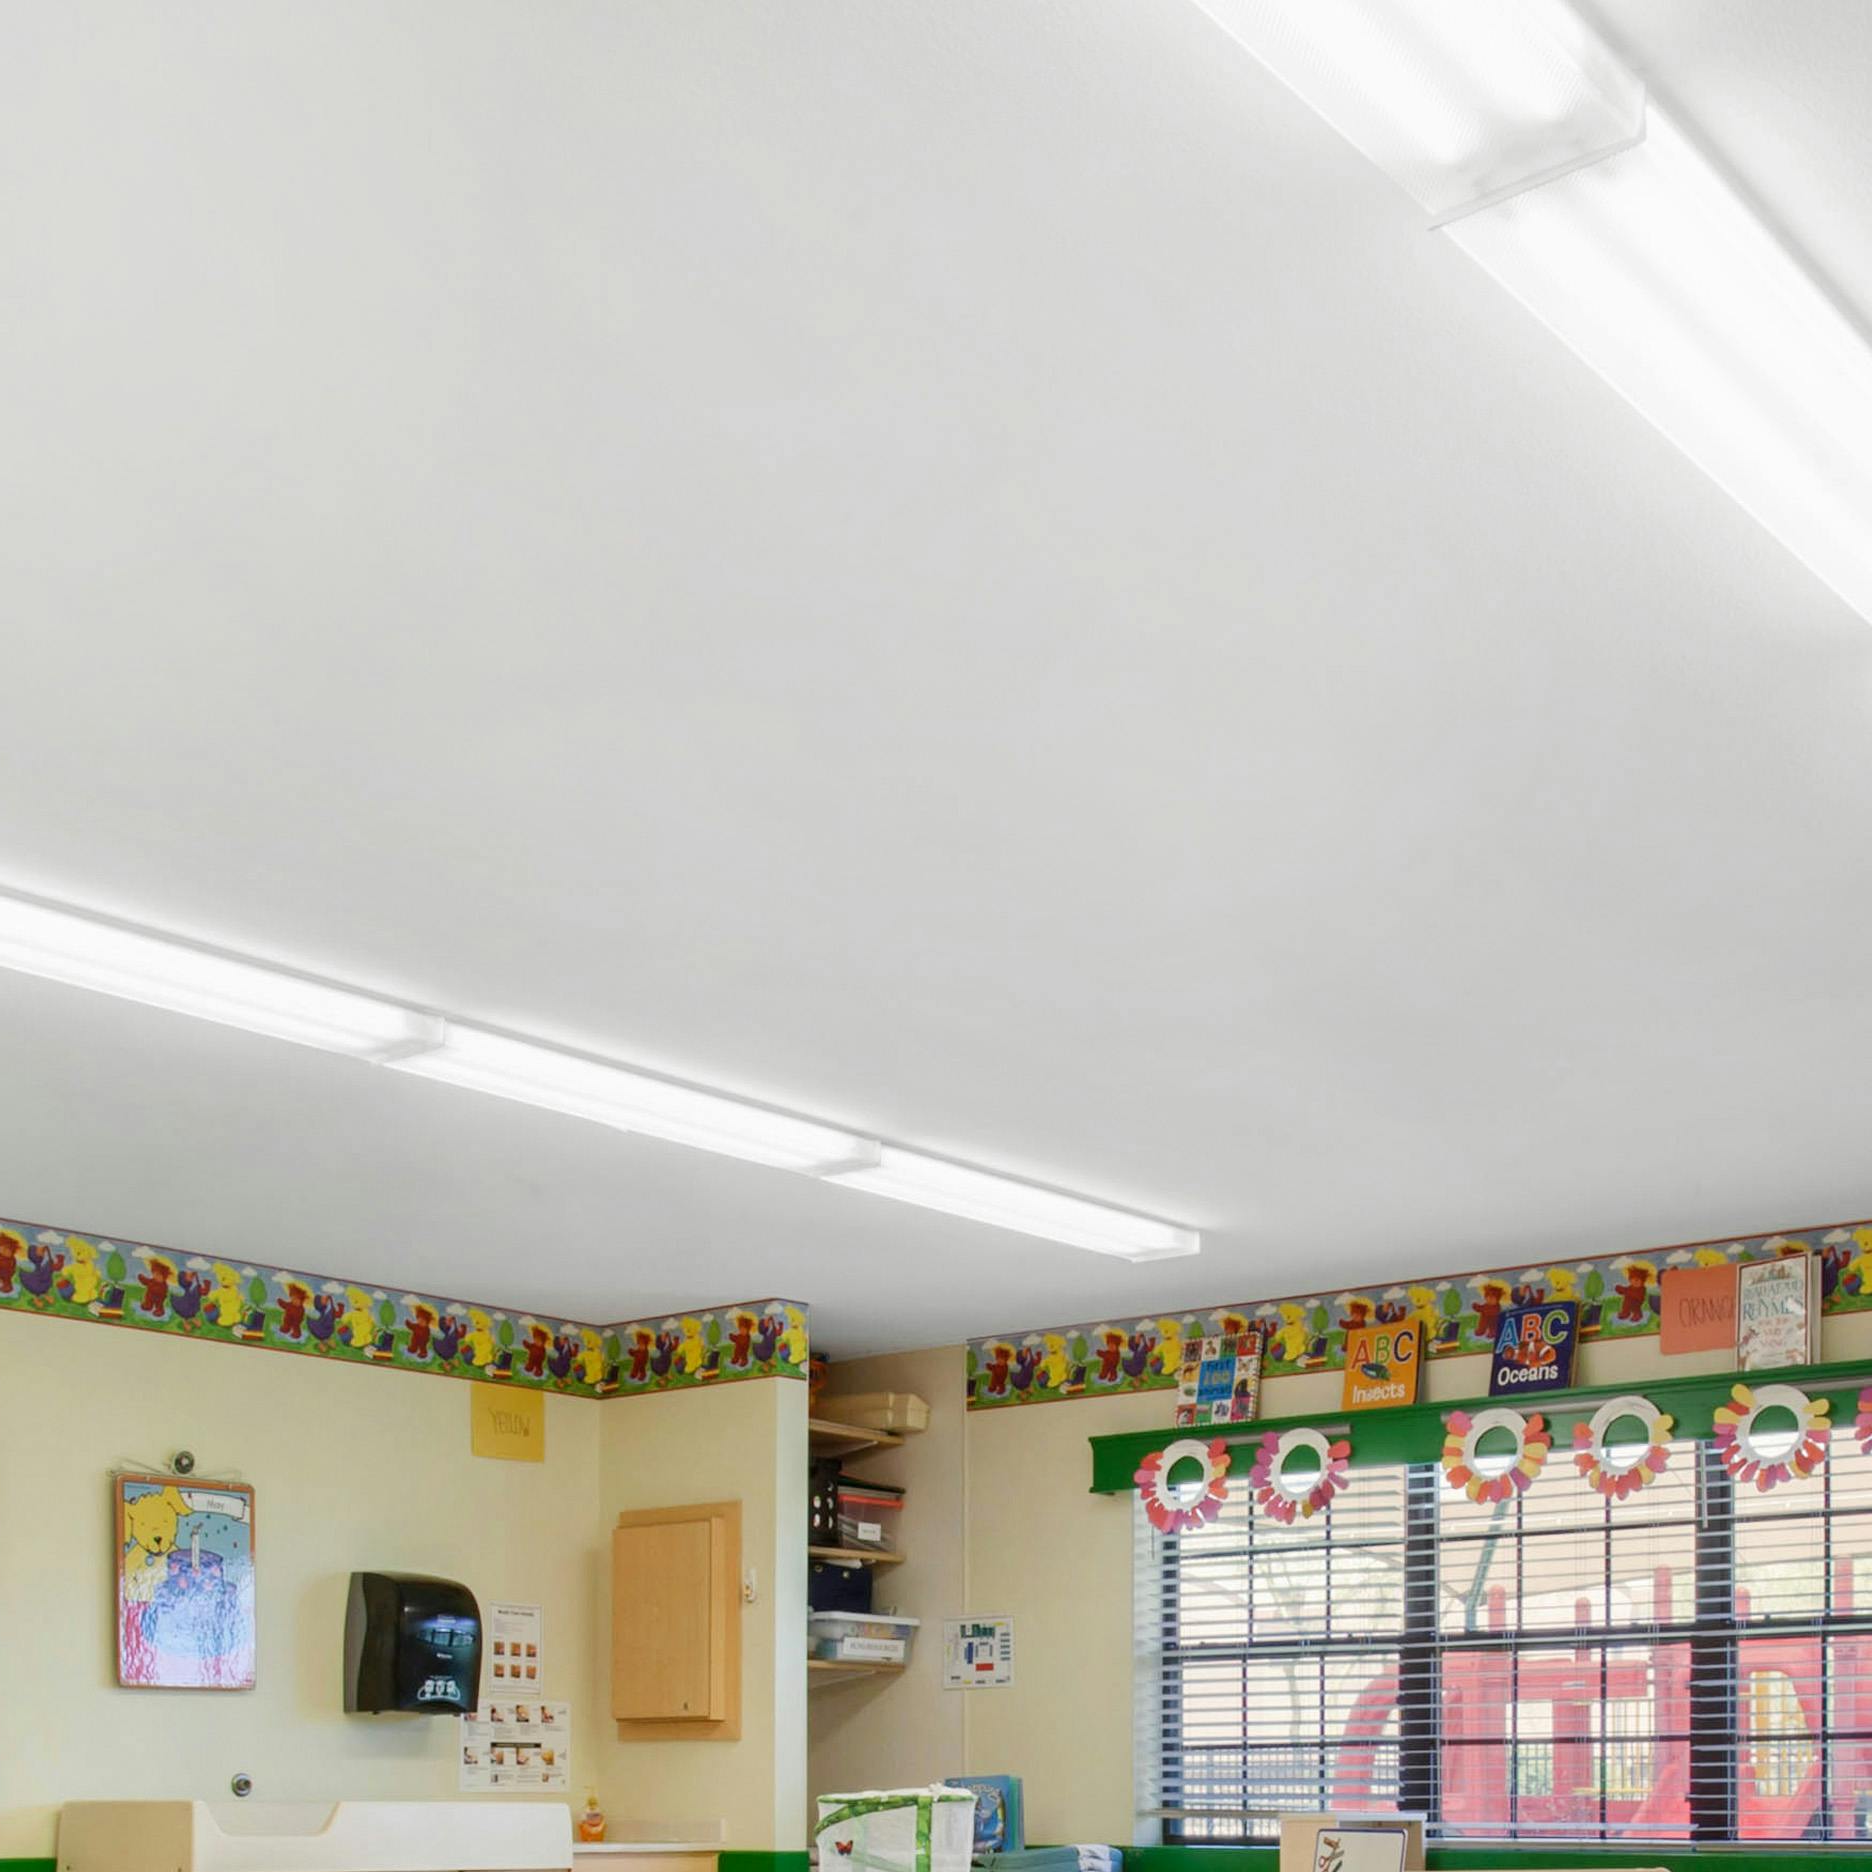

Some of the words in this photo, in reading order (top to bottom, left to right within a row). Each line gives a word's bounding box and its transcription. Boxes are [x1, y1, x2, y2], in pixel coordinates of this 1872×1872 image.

[1743, 1296, 1804, 1321] RHYME
[1495, 1308, 1570, 1355] ABC
[1350, 1329, 1415, 1371] ABC
[1497, 1364, 1560, 1386] Oceans
[1352, 1383, 1406, 1404] Insects
